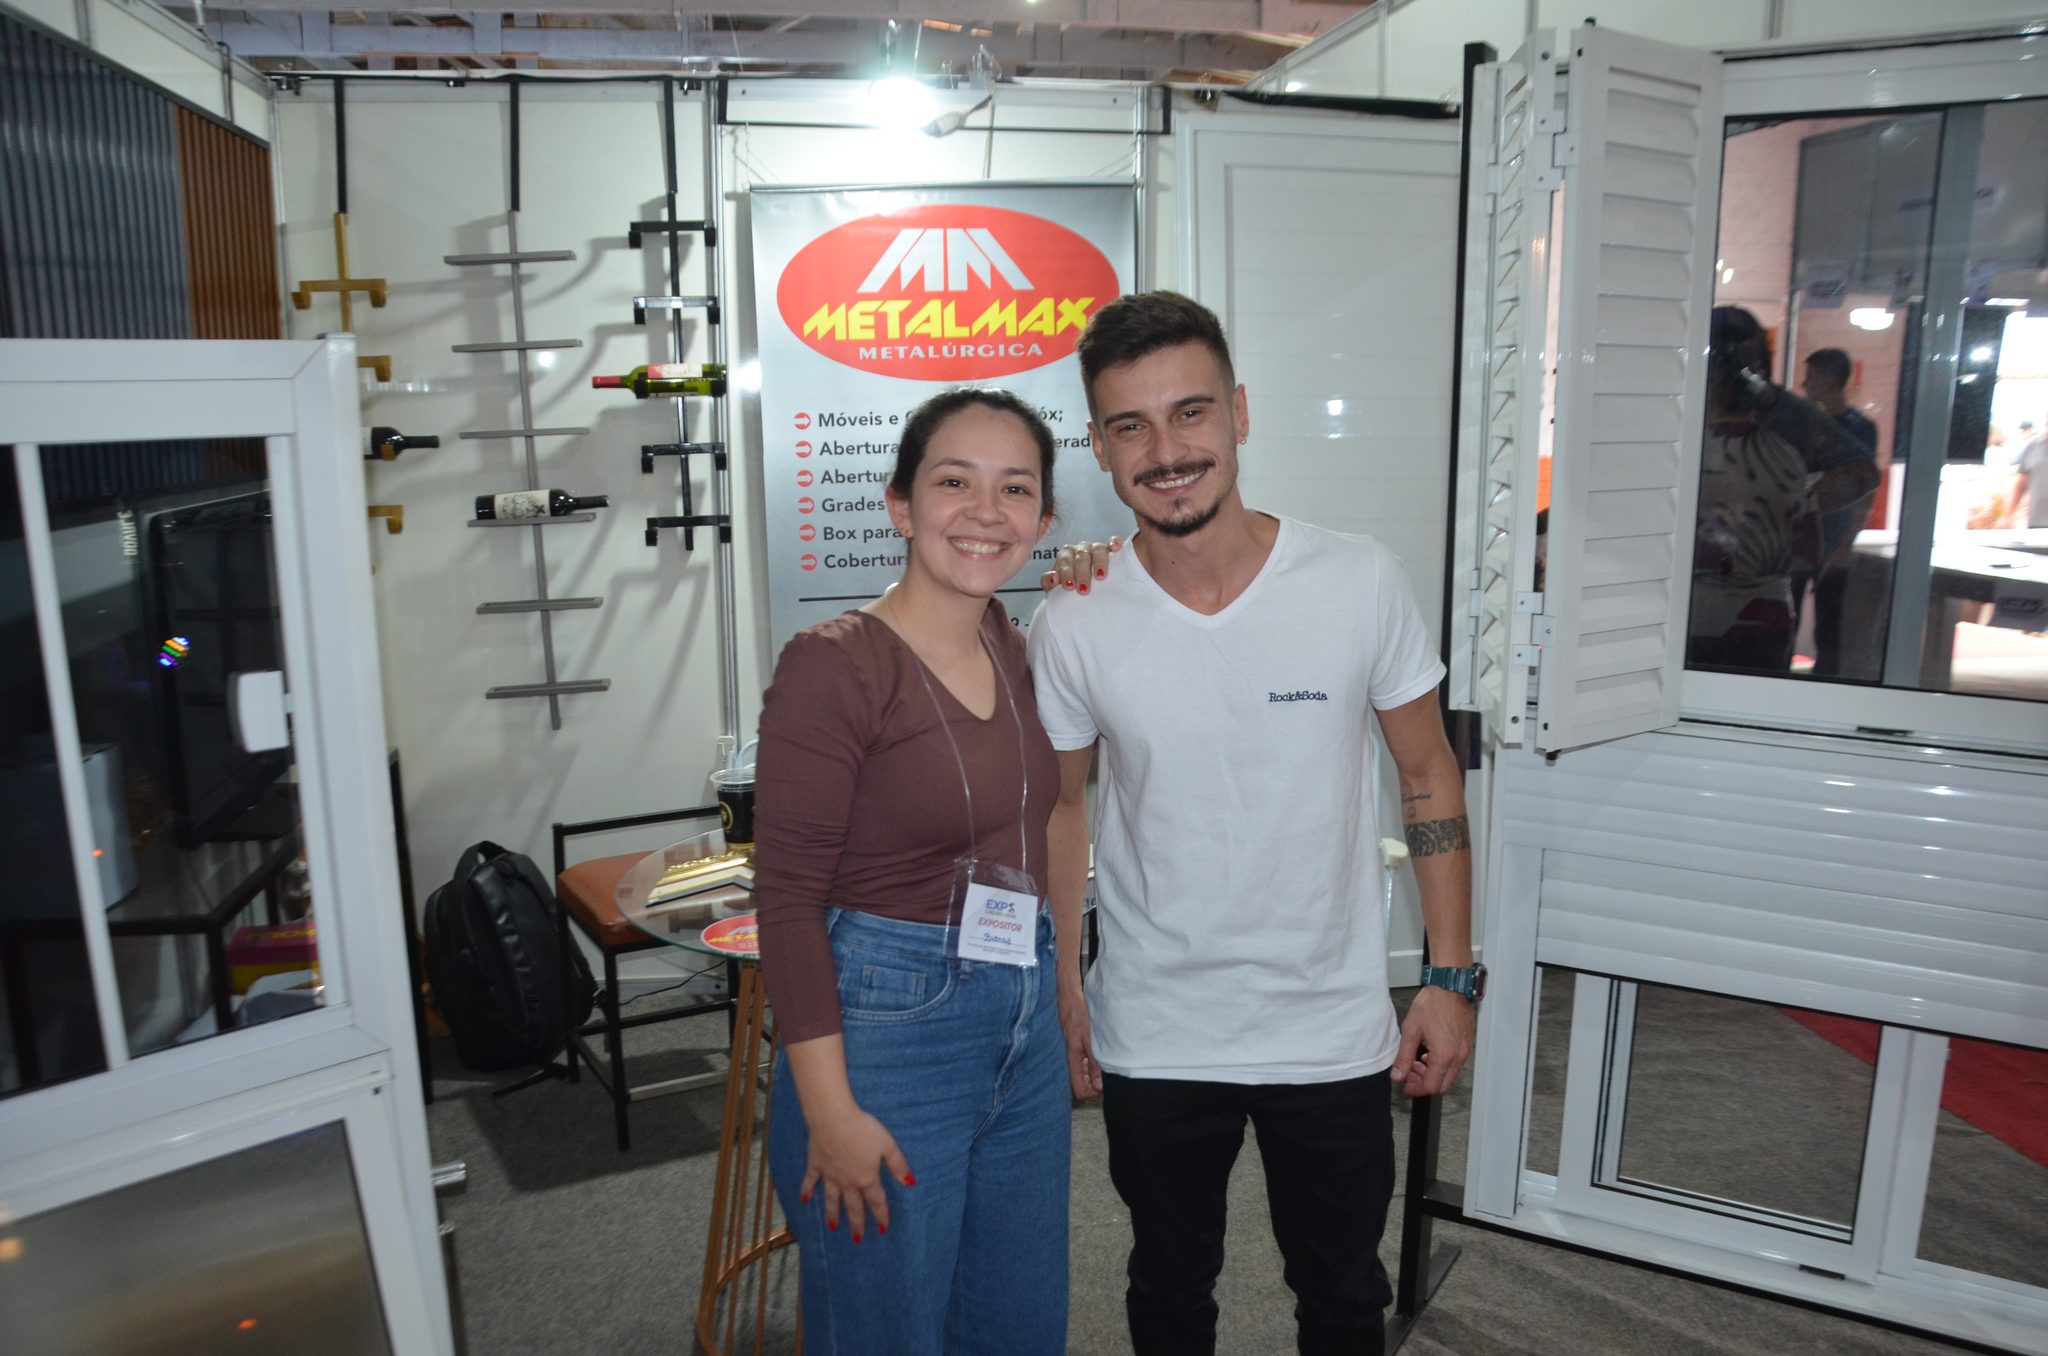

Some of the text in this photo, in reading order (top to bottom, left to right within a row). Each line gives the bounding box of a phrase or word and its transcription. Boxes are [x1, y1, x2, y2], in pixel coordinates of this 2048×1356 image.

[803, 297, 1095, 341] METALMAX
[859, 342, 1043, 361] METALÚRGICA
[818, 411, 882, 427] Móveis
[889, 414, 898, 425] e
[1039, 406, 1063, 422] óx;
[1053, 433, 1090, 448] erad
[821, 468, 891, 484] Abertur
[821, 496, 885, 513] Grades
[823, 526, 904, 543] Box para
[824, 553, 908, 568] Cobertur
[1268, 691, 1328, 702] Rock&Soda
